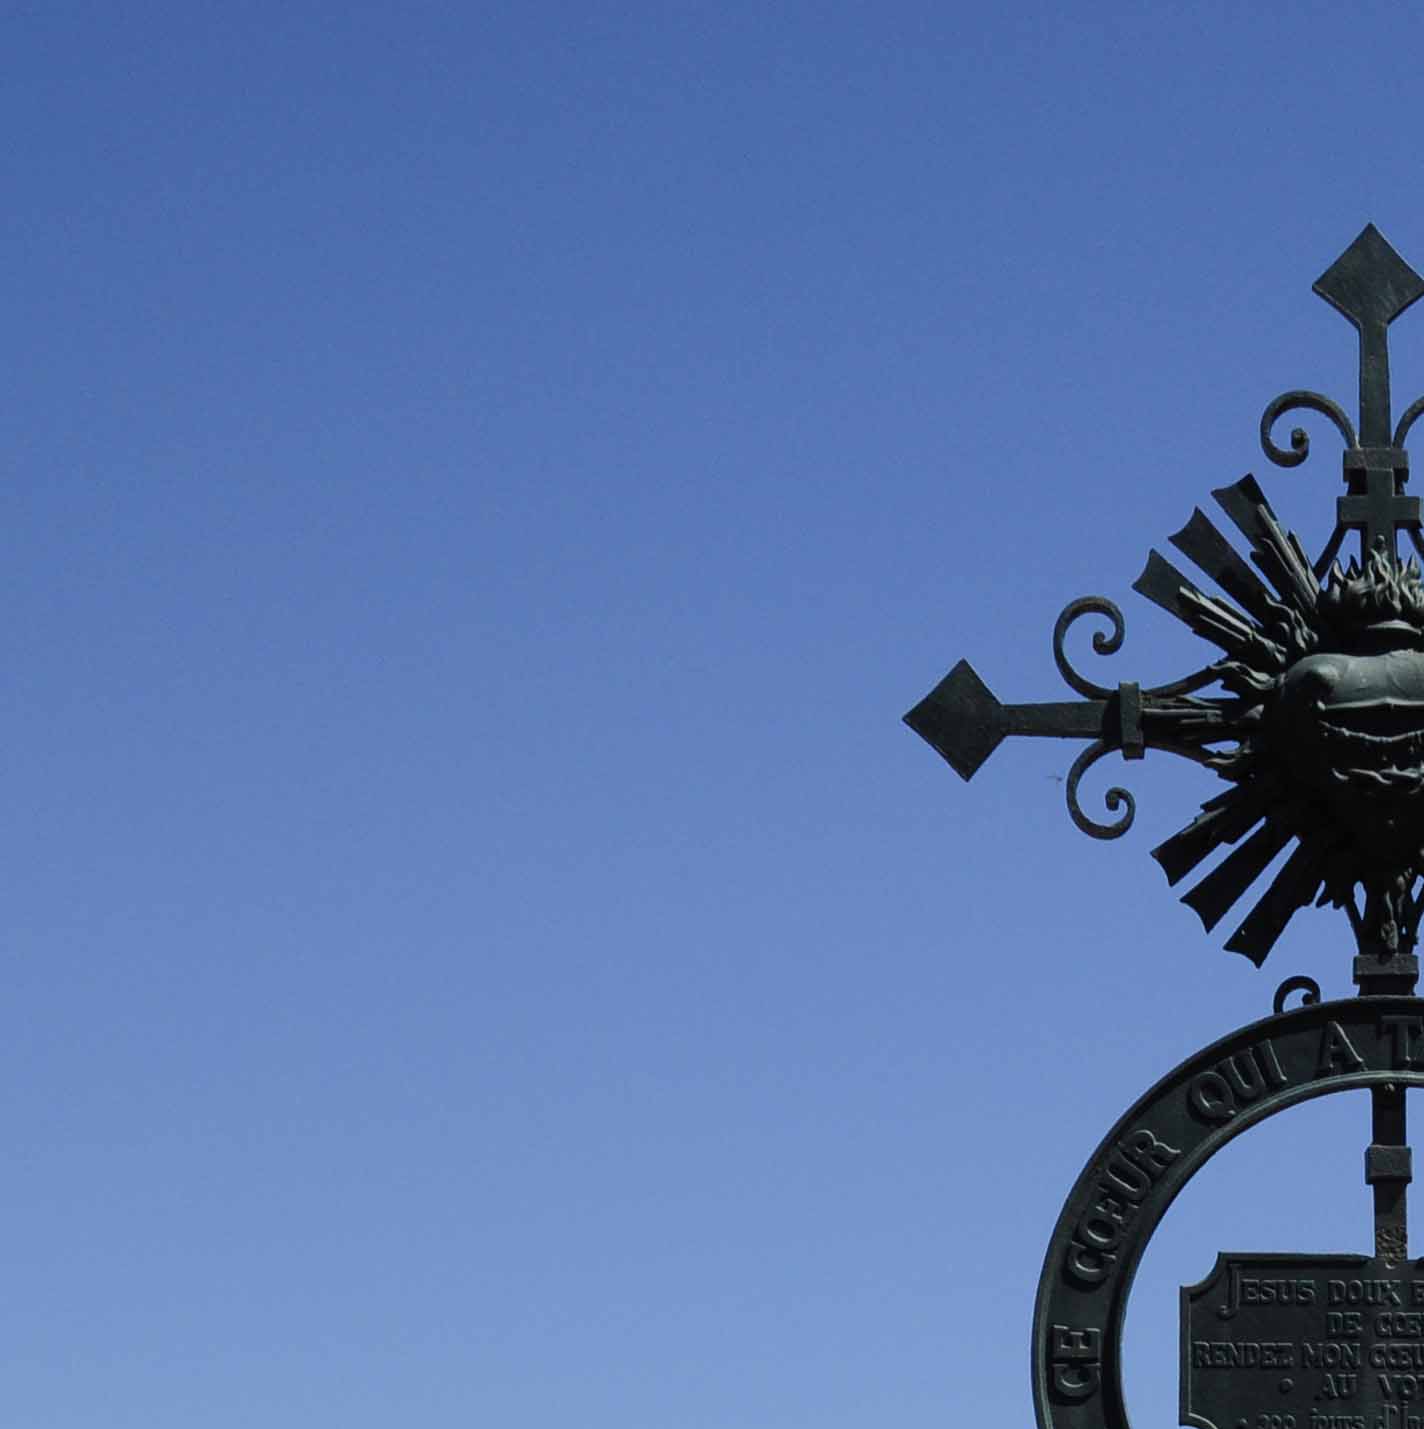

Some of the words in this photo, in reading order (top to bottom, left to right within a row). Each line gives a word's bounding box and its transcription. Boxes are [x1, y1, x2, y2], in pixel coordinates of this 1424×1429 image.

[1050, 1322, 1102, 1406] CE
[1186, 1036, 1288, 1127] QUI
[1313, 1018, 1368, 1078] A
[1327, 1278, 1401, 1306] DOUX
[1326, 1311, 1363, 1339] DE
[1191, 1341, 1296, 1370] RENDEZ
[1301, 1342, 1361, 1370] MON
[1318, 1373, 1359, 1402] AU
